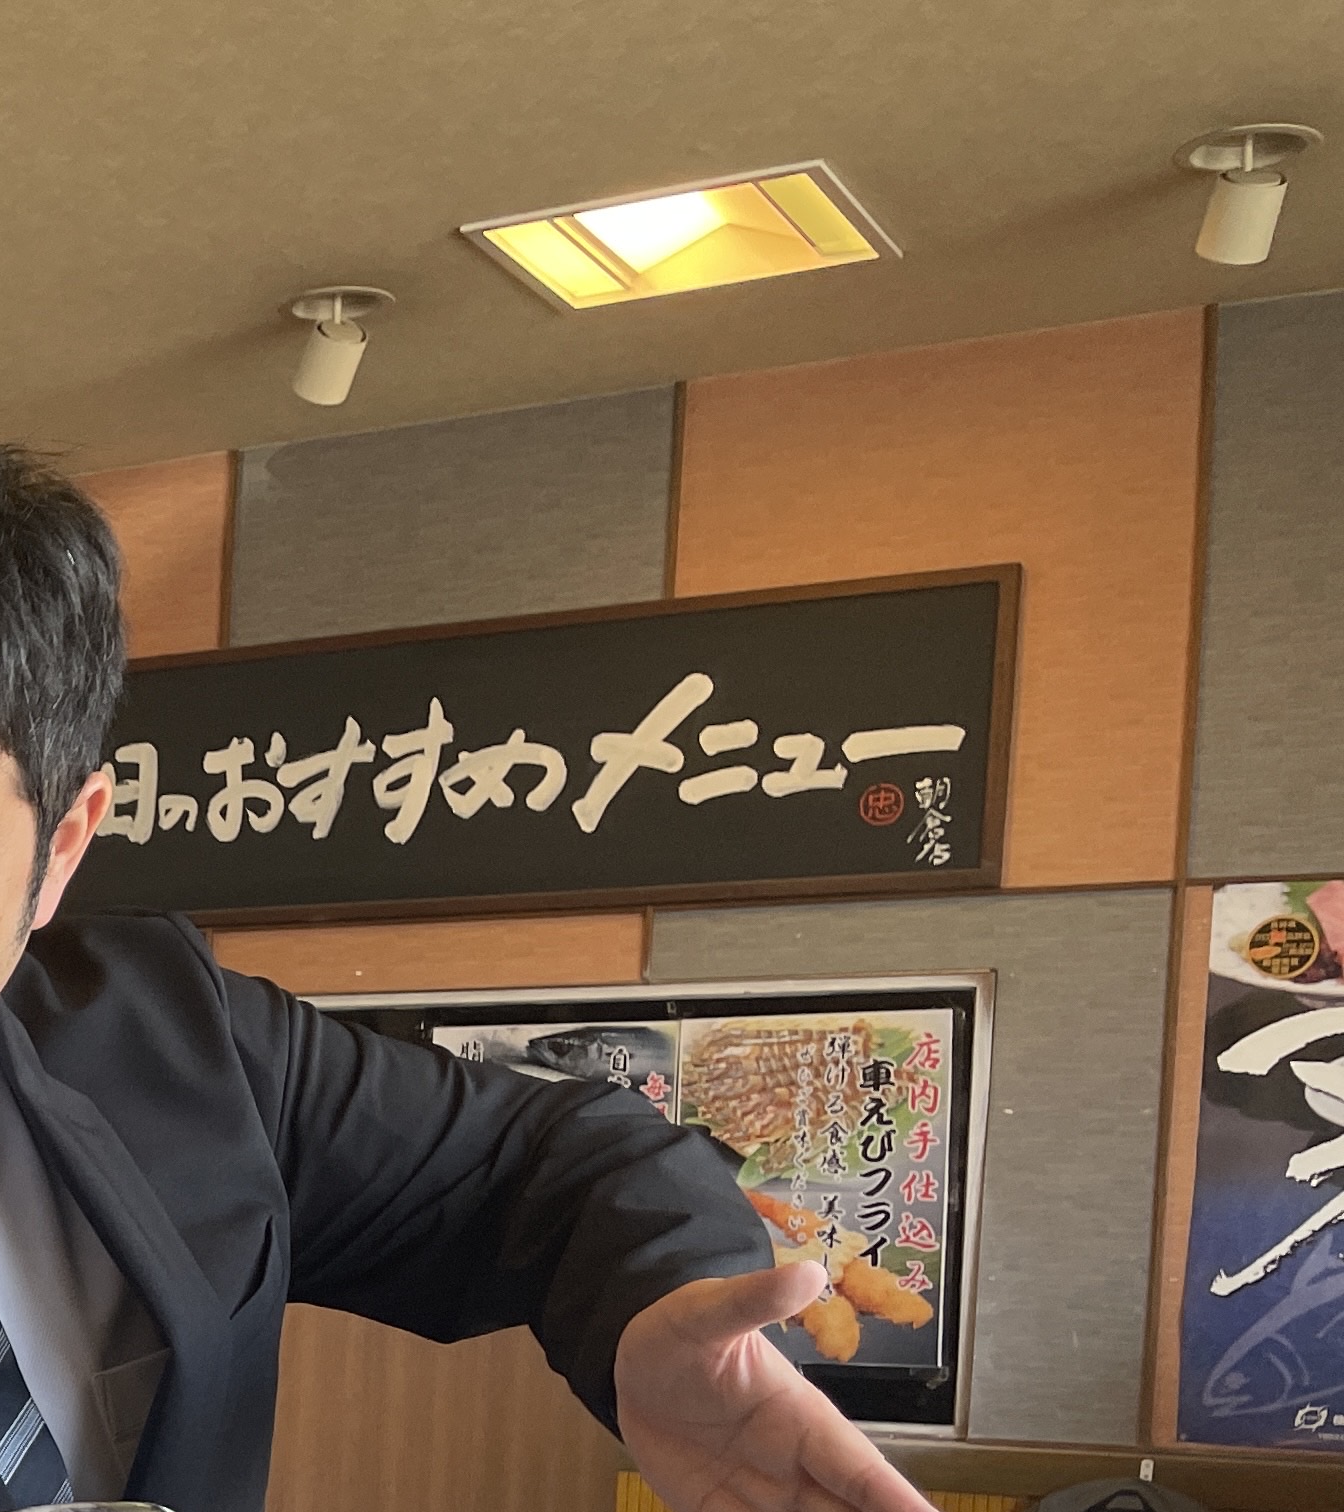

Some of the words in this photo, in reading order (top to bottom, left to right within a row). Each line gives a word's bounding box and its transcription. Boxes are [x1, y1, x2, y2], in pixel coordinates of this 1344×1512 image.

[855, 1057, 897, 1269] 車えびフライ
[896, 1031, 942, 1295] 店内手仕込み
